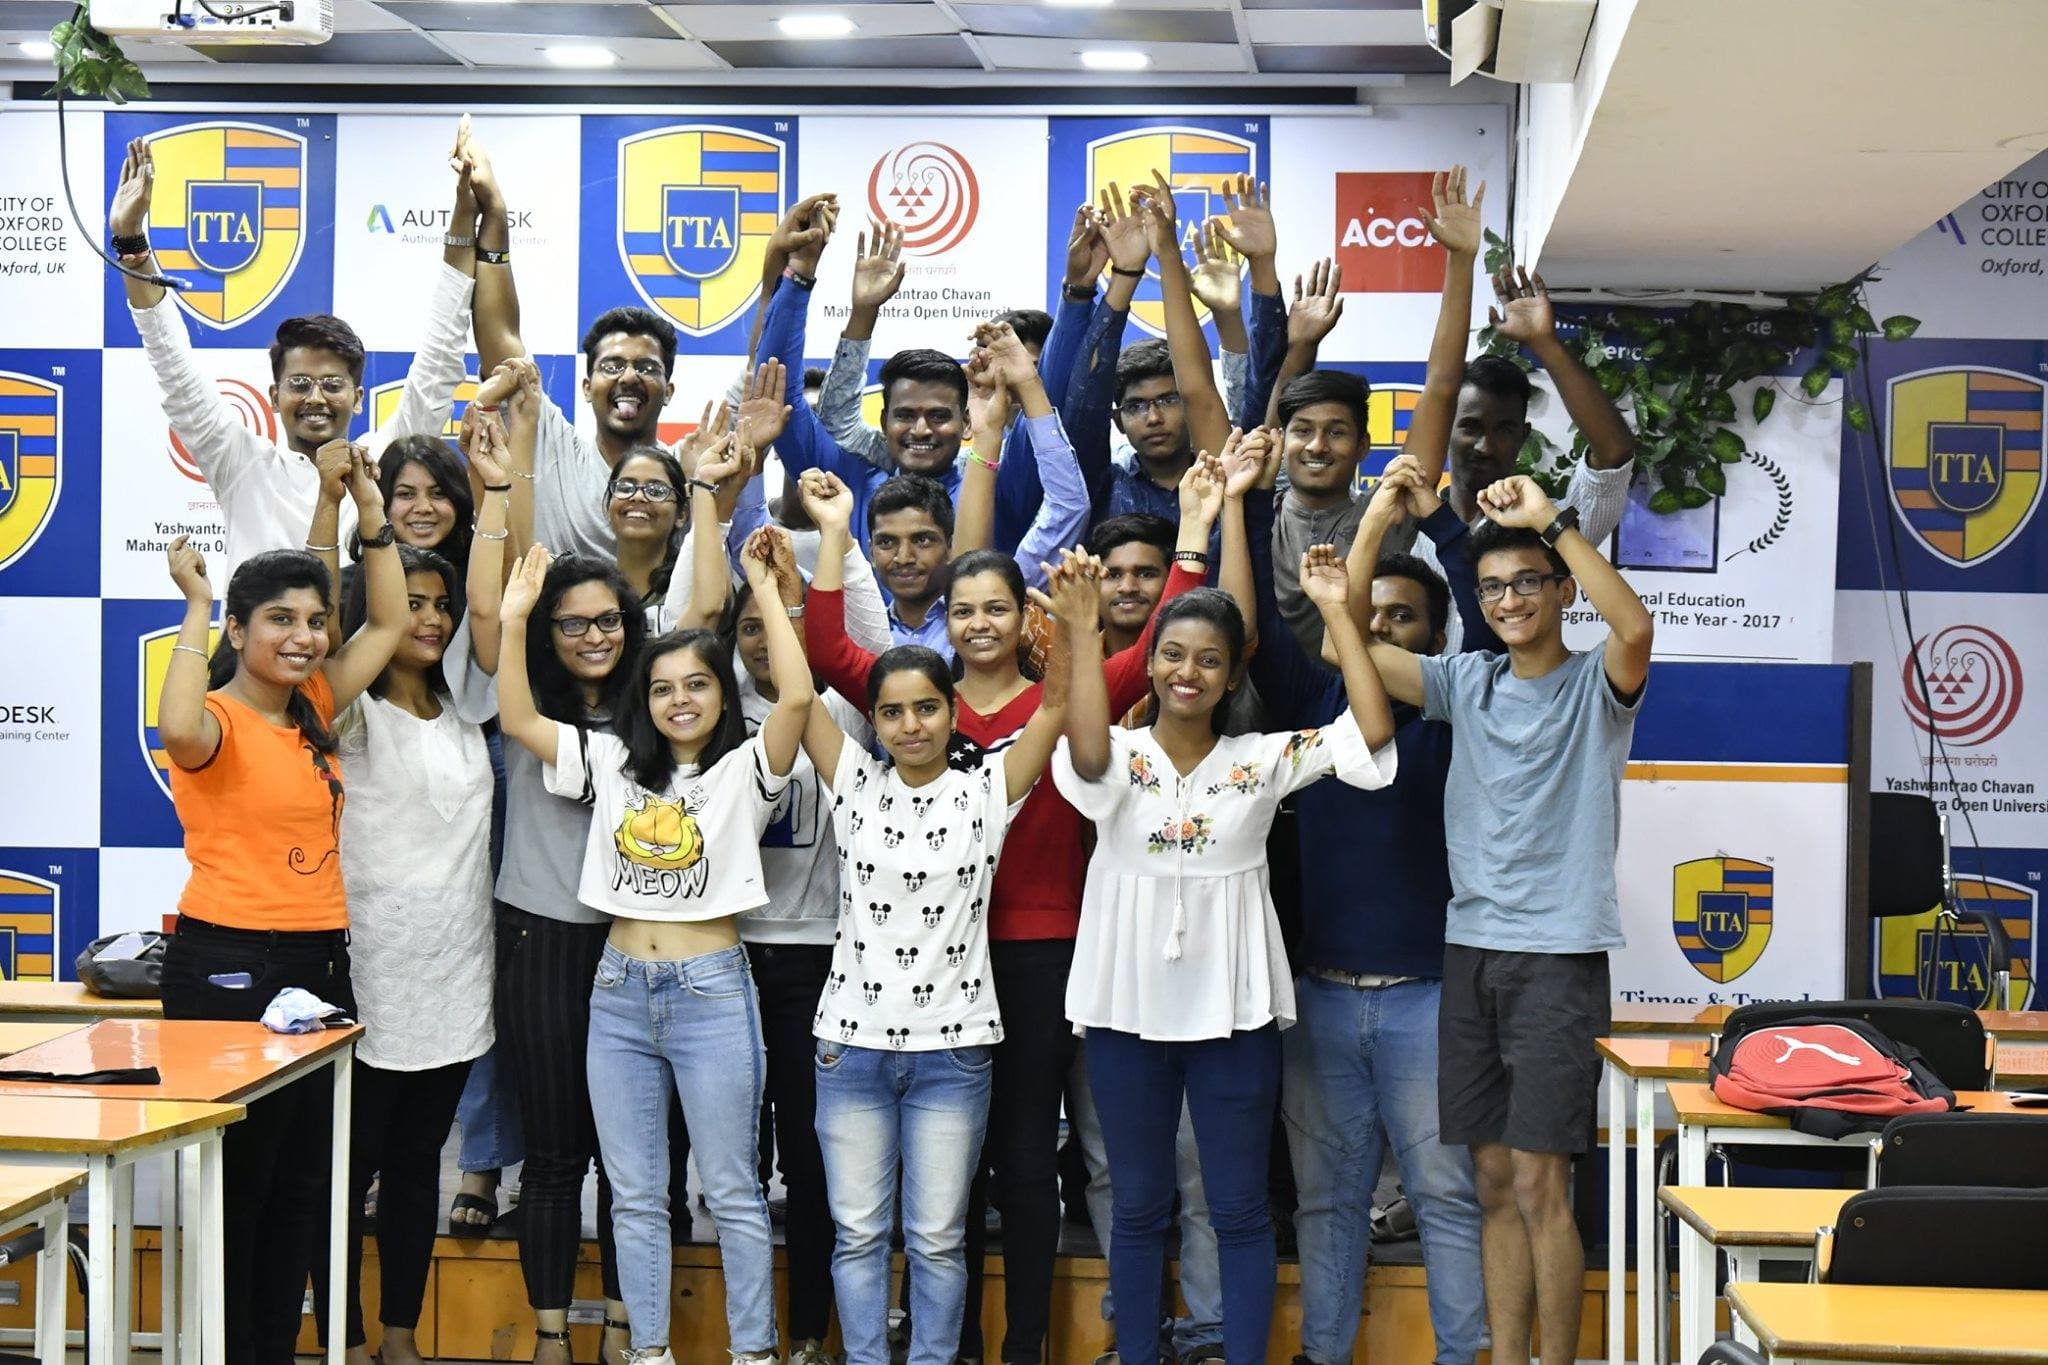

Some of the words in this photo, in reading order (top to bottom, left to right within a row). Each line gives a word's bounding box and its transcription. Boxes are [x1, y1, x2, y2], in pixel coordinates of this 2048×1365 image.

[296, 118, 310, 128] TM
[774, 121, 789, 132] TM
[1244, 123, 1259, 133] TM
[0, 197, 27, 212] ITY
[31, 197, 54, 212] OF
[402, 209, 532, 228] AUTSK
[1982, 204, 2048, 222] OXFO
[192, 211, 256, 243] TTA
[667, 215, 733, 248] TTA
[0, 236, 67, 251] OLLEGE
[0, 261, 41, 277] xford,
[47, 262, 66, 274] UK
[1981, 258, 2044, 276] Oxford,
[942, 288, 991, 300] Chavan
[914, 306, 948, 320] Open
[52, 366, 66, 377] TM
[1934, 453, 1997, 483] TTA
[154, 522, 226, 535] Yashwantra
[1668, 592, 1745, 608] Education
[1661, 611, 1689, 625] The
[1694, 612, 1728, 626] Year
[1743, 614, 1781, 628] 2017
[35, 730, 70, 741] Center
[1886, 777, 1978, 793] Yashwantrao
[1982, 780, 2035, 794] Chavan
[1951, 798, 1988, 813] Open
[48, 865, 63, 875] TM
[612, 851, 709, 899] MEOW
[2027, 871, 2042, 881] TM
[1702, 911, 1743, 933] TTA
